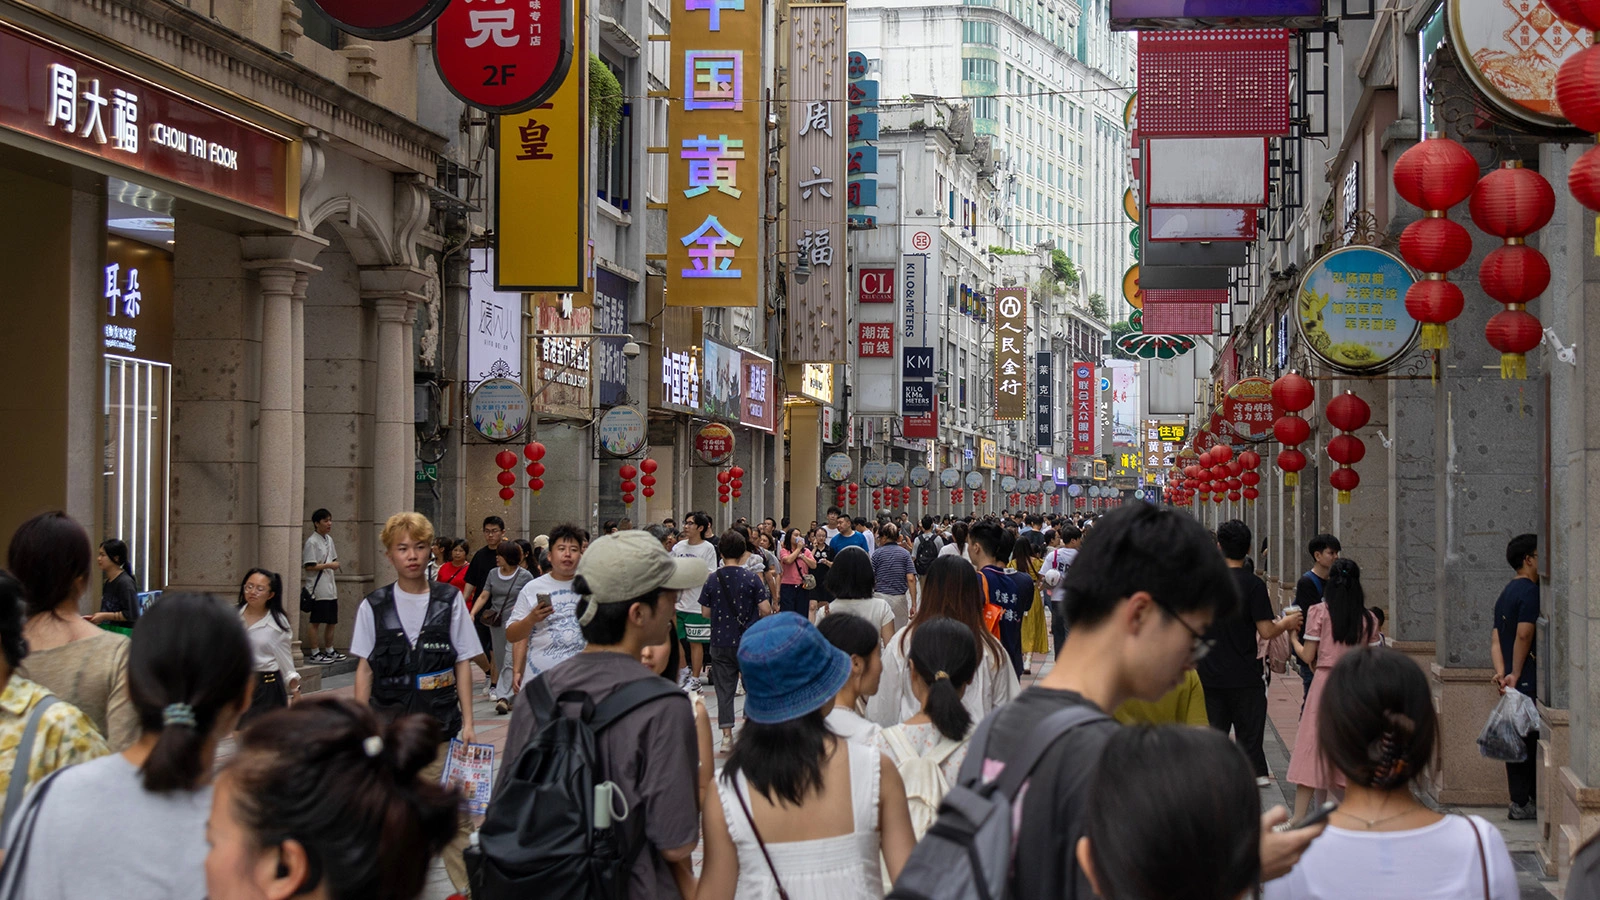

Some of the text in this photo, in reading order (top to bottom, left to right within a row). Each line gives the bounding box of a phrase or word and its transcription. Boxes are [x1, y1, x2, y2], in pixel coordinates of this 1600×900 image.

[463, 0, 520, 48] 兄
[482, 64, 517, 86] 2F
[48, 63, 138, 154] 周大福
[154, 123, 238, 170] CHOW TAI FOOK
[797, 100, 834, 267] 周六福
[104, 263, 142, 318] 耳朵
[861, 273, 892, 294] CL
[906, 263, 915, 338] KILO&METERS
[862, 326, 891, 339] 潮流
[862, 341, 891, 355] 前线
[662, 346, 699, 408] 中国黄金
[906, 355, 930, 368] KM
[1000, 322, 1022, 396] 人民金行
[1078, 380, 1089, 442] 联合大众眼镜
[1158, 426, 1184, 437] 住宿
